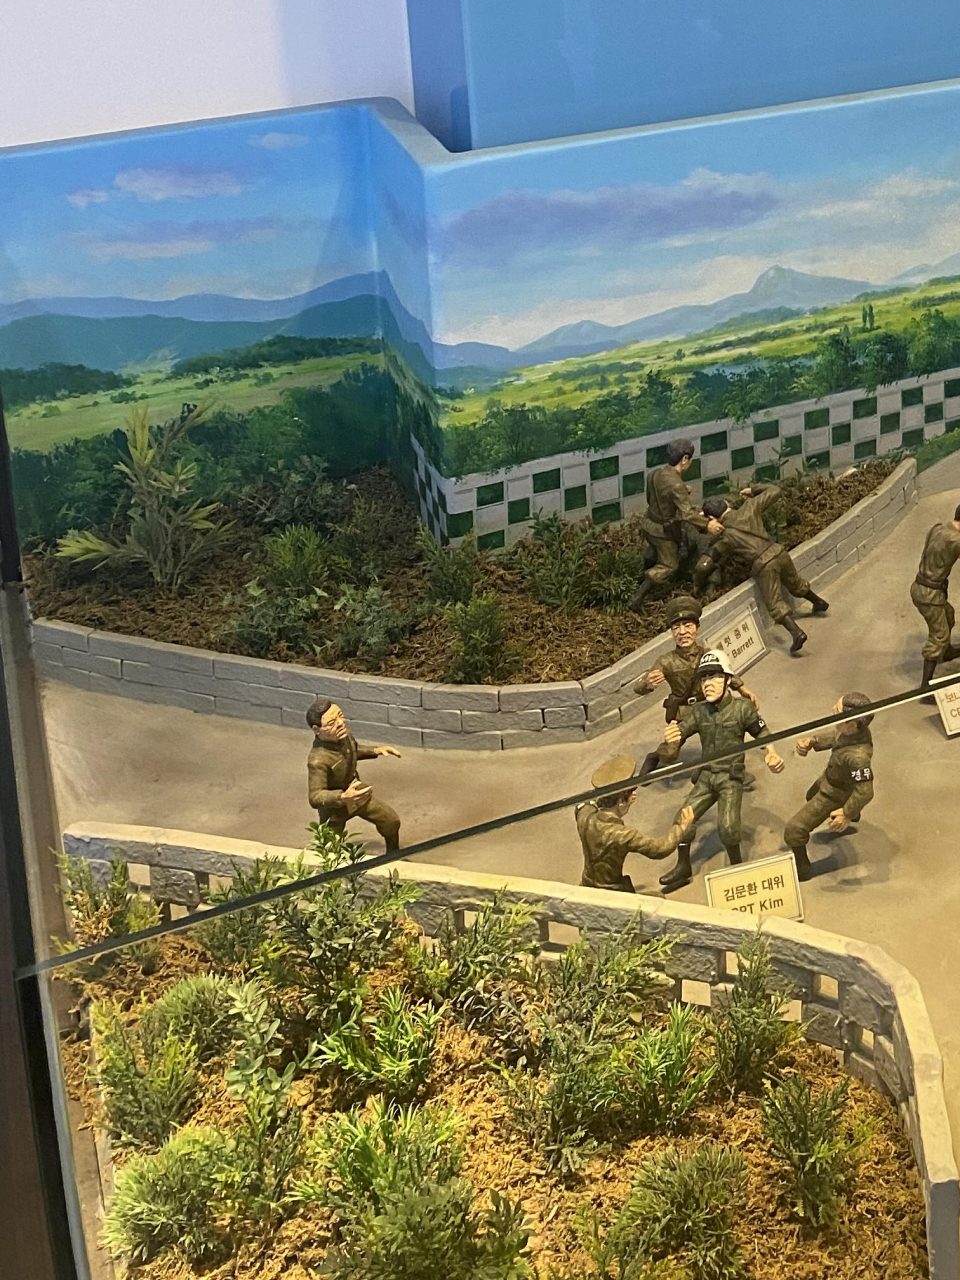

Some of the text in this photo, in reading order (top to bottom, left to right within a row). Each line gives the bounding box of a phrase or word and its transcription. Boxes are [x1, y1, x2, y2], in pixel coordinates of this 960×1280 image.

[731, 637, 755, 659] Barrett
[723, 874, 785, 902] 김문환 대위
[759, 897, 784, 913] Kim
